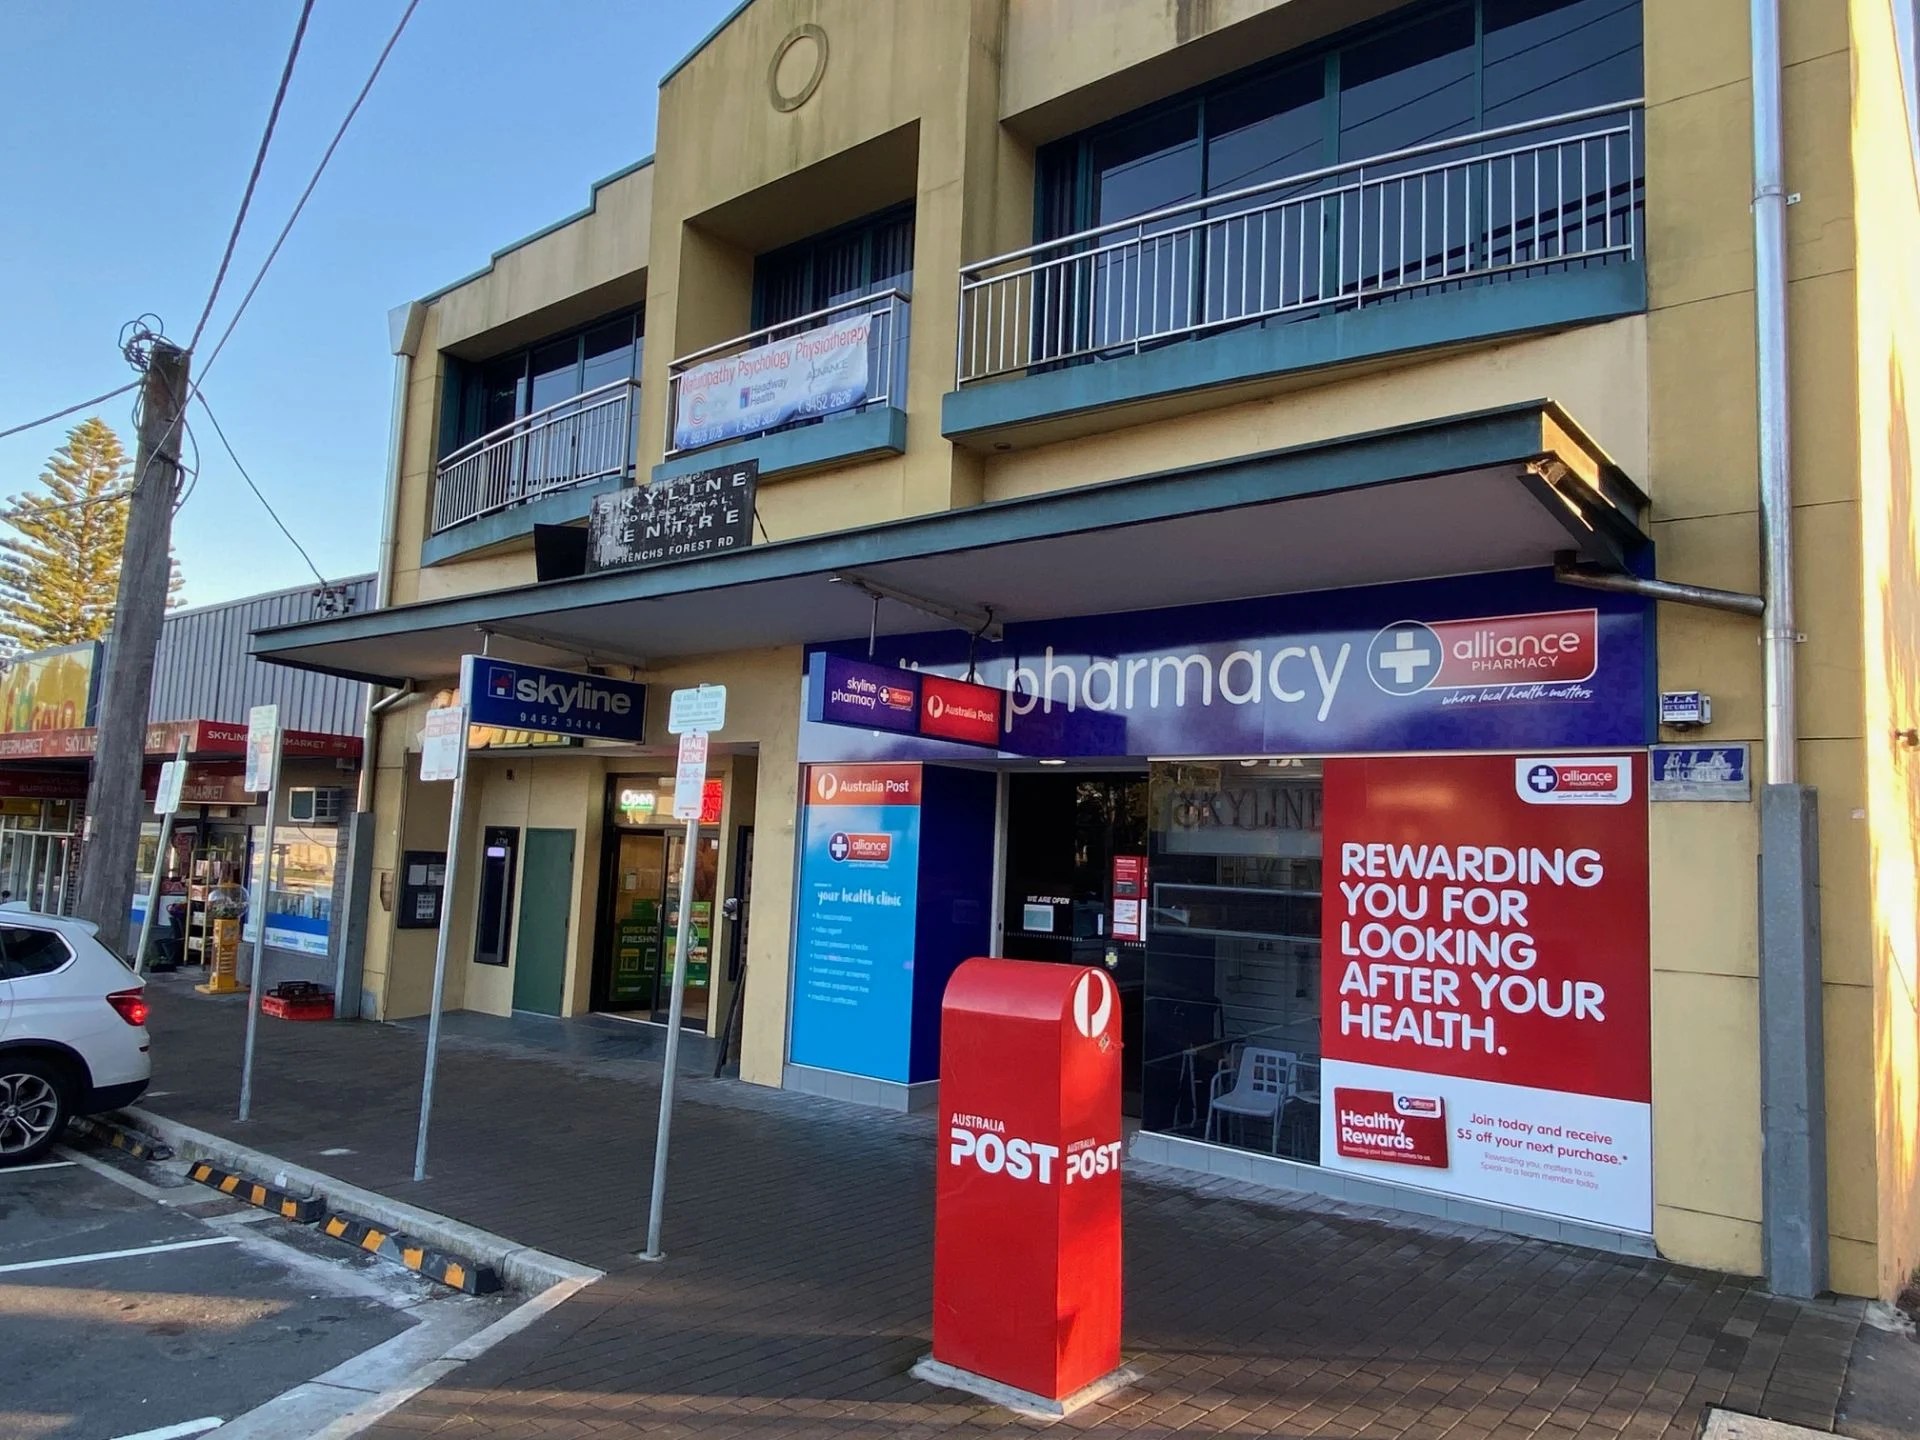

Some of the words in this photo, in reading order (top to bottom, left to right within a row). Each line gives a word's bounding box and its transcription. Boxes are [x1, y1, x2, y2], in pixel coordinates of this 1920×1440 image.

[738, 350, 792, 377] Psychology
[795, 326, 870, 360] Physiotherapy
[751, 377, 788, 394] Headway
[600, 472, 747, 514] SKYLINE
[669, 540, 712, 556] FOREST
[718, 536, 734, 547] RD
[1453, 630, 1580, 660] alliance
[1472, 656, 1559, 671] PHARMACY
[516, 674, 631, 715] skyline
[847, 677, 877, 694] skyline
[1005, 644, 1351, 734] pharmacy
[1442, 692, 1474, 706] where
[1478, 687, 1504, 703] local
[1507, 684, 1548, 700] health
[1549, 684, 1593, 699] matters
[831, 690, 876, 710] pharmacy
[520, 711, 557, 727] 9452
[566, 718, 602, 732] 3444
[945, 704, 977, 720] Australia
[978, 710, 994, 722] Post
[283, 737, 326, 748] MARKET
[840, 780, 884, 792] Australia
[886, 780, 909, 792] Post
[1562, 768, 1613, 782] alliance
[621, 789, 655, 806] Open
[852, 839, 887, 852] alliance
[1341, 842, 1604, 887] REWARDING
[817, 890, 840, 906] your
[842, 887, 874, 905] health
[876, 890, 902, 907] clinic
[1052, 896, 1070, 905] OPEN
[1339, 881, 1428, 921] YOU
[1443, 886, 1529, 928] FOR
[1341, 920, 1537, 971] LOOKING
[1339, 960, 1460, 1007] AFTER
[1471, 971, 1606, 1022] YOUR
[1340, 1000, 1508, 1056] HEALTH.
[952, 1112, 1005, 1133] AUSTRALIA
[1340, 1109, 1405, 1133] Healthy
[1470, 1113, 1494, 1126] Join
[1498, 1117, 1533, 1135] today
[1537, 1124, 1562, 1137] and
[1566, 1129, 1613, 1145] receive
[1067, 1137, 1095, 1153] AUSTRALIA
[1342, 1127, 1414, 1150] Rewards
[1457, 1128, 1472, 1140] $5
[1476, 1131, 1493, 1143] off
[1495, 1136, 1523, 1149] your
[1526, 1141, 1554, 1154] next
[951, 1128, 1059, 1184] POST
[1066, 1141, 1121, 1185] POST
[1484, 1151, 1525, 1167] Rewarding
[1543, 1162, 1573, 1174] matters
[1574, 1167, 1582, 1176] to
[1480, 1161, 1503, 1173] Speak
[1505, 1166, 1512, 1174] to
[1521, 1168, 1540, 1179] team
[1541, 1173, 1575, 1185] member
